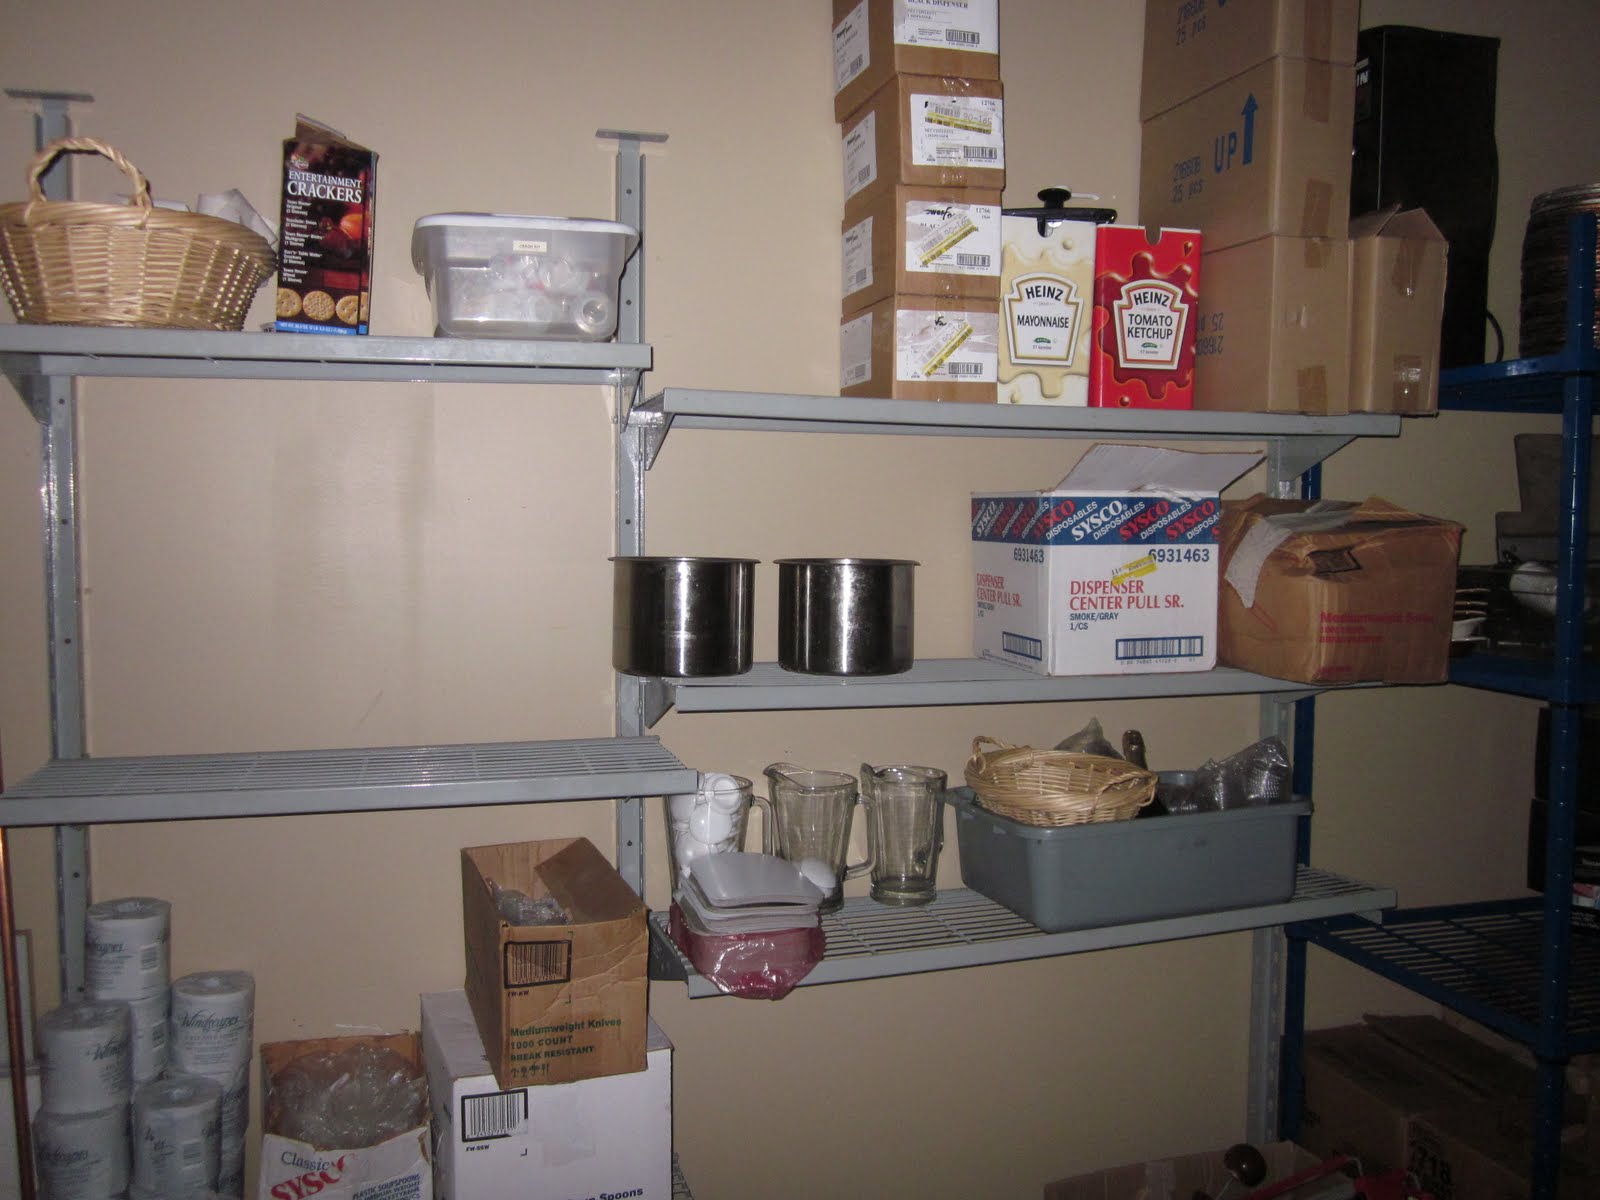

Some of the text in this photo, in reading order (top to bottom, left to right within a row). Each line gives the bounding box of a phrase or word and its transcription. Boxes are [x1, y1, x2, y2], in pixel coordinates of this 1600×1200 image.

[1215, 132, 1237, 174] UP
[288, 170, 362, 189] ENTERTAINMENT
[287, 180, 362, 204] CRACKERS
[1025, 285, 1063, 301] HEINZ
[1134, 291, 1170, 307] HEINZ
[1017, 314, 1069, 328] MAYONNAISE
[1128, 314, 1173, 327] TOMATO
[1127, 327, 1173, 340] KETCHUP
[1046, 501, 1098, 540] DISPOSABLES
[1093, 501, 1146, 540] DISPOSABLES
[1119, 500, 1170, 541] SYSCO
[1140, 502, 1192, 540] DISPOSABLES
[1166, 500, 1215, 541] SYSCO
[1013, 548, 1045, 563] 6931463
[1148, 548, 1210, 562] 6931463
[976, 573, 1005, 589] DISPENSER
[1070, 580, 1145, 595] DISPENSER
[977, 587, 996, 602] CENTER
[997, 591, 1012, 605] PULL
[1070, 594, 1185, 611] CENTER PULL SR.
[1070, 612, 1119, 622] SMOKE/GRAY
[1070, 622, 1088, 631] 1/CS
[511, 1018, 621, 1037] Mediumweight Knives
[511, 1036, 574, 1050] 1000 COUNT
[511, 1046, 596, 1062] BREAK RESISTANT
[281, 1151, 331, 1171] Classic
[599, 1188, 643, 1200] Spoons
